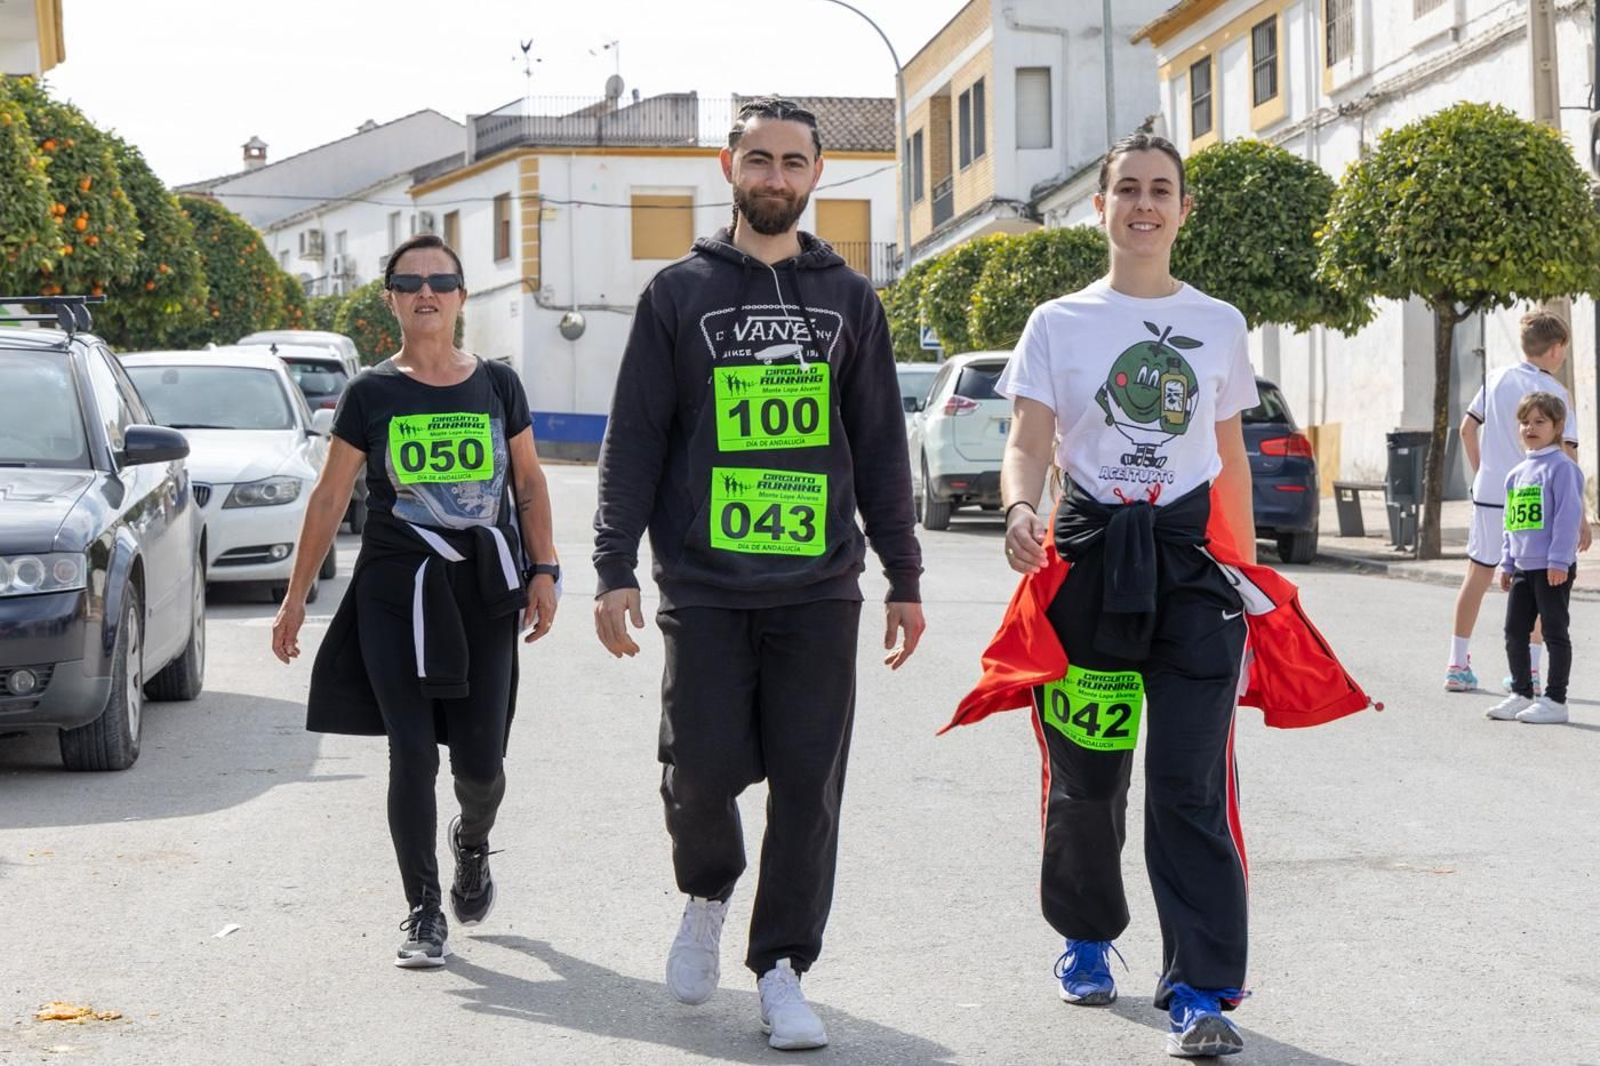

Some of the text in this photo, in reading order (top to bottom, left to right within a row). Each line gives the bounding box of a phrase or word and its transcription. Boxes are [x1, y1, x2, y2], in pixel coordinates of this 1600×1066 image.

[760, 374, 823, 385] RUNNING
[729, 397, 819, 437] 100
[428, 422, 485, 430] RUNNING
[400, 438, 484, 473] 050
[763, 473, 816, 484] CIRCUITO
[757, 480, 822, 494] RUNNING
[721, 502, 816, 543] 043
[1083, 673, 1135, 682] CIRCUITO
[1077, 679, 1140, 691] RUNNING
[1078, 689, 1098, 698] Monte
[1052, 688, 1132, 738] 042
